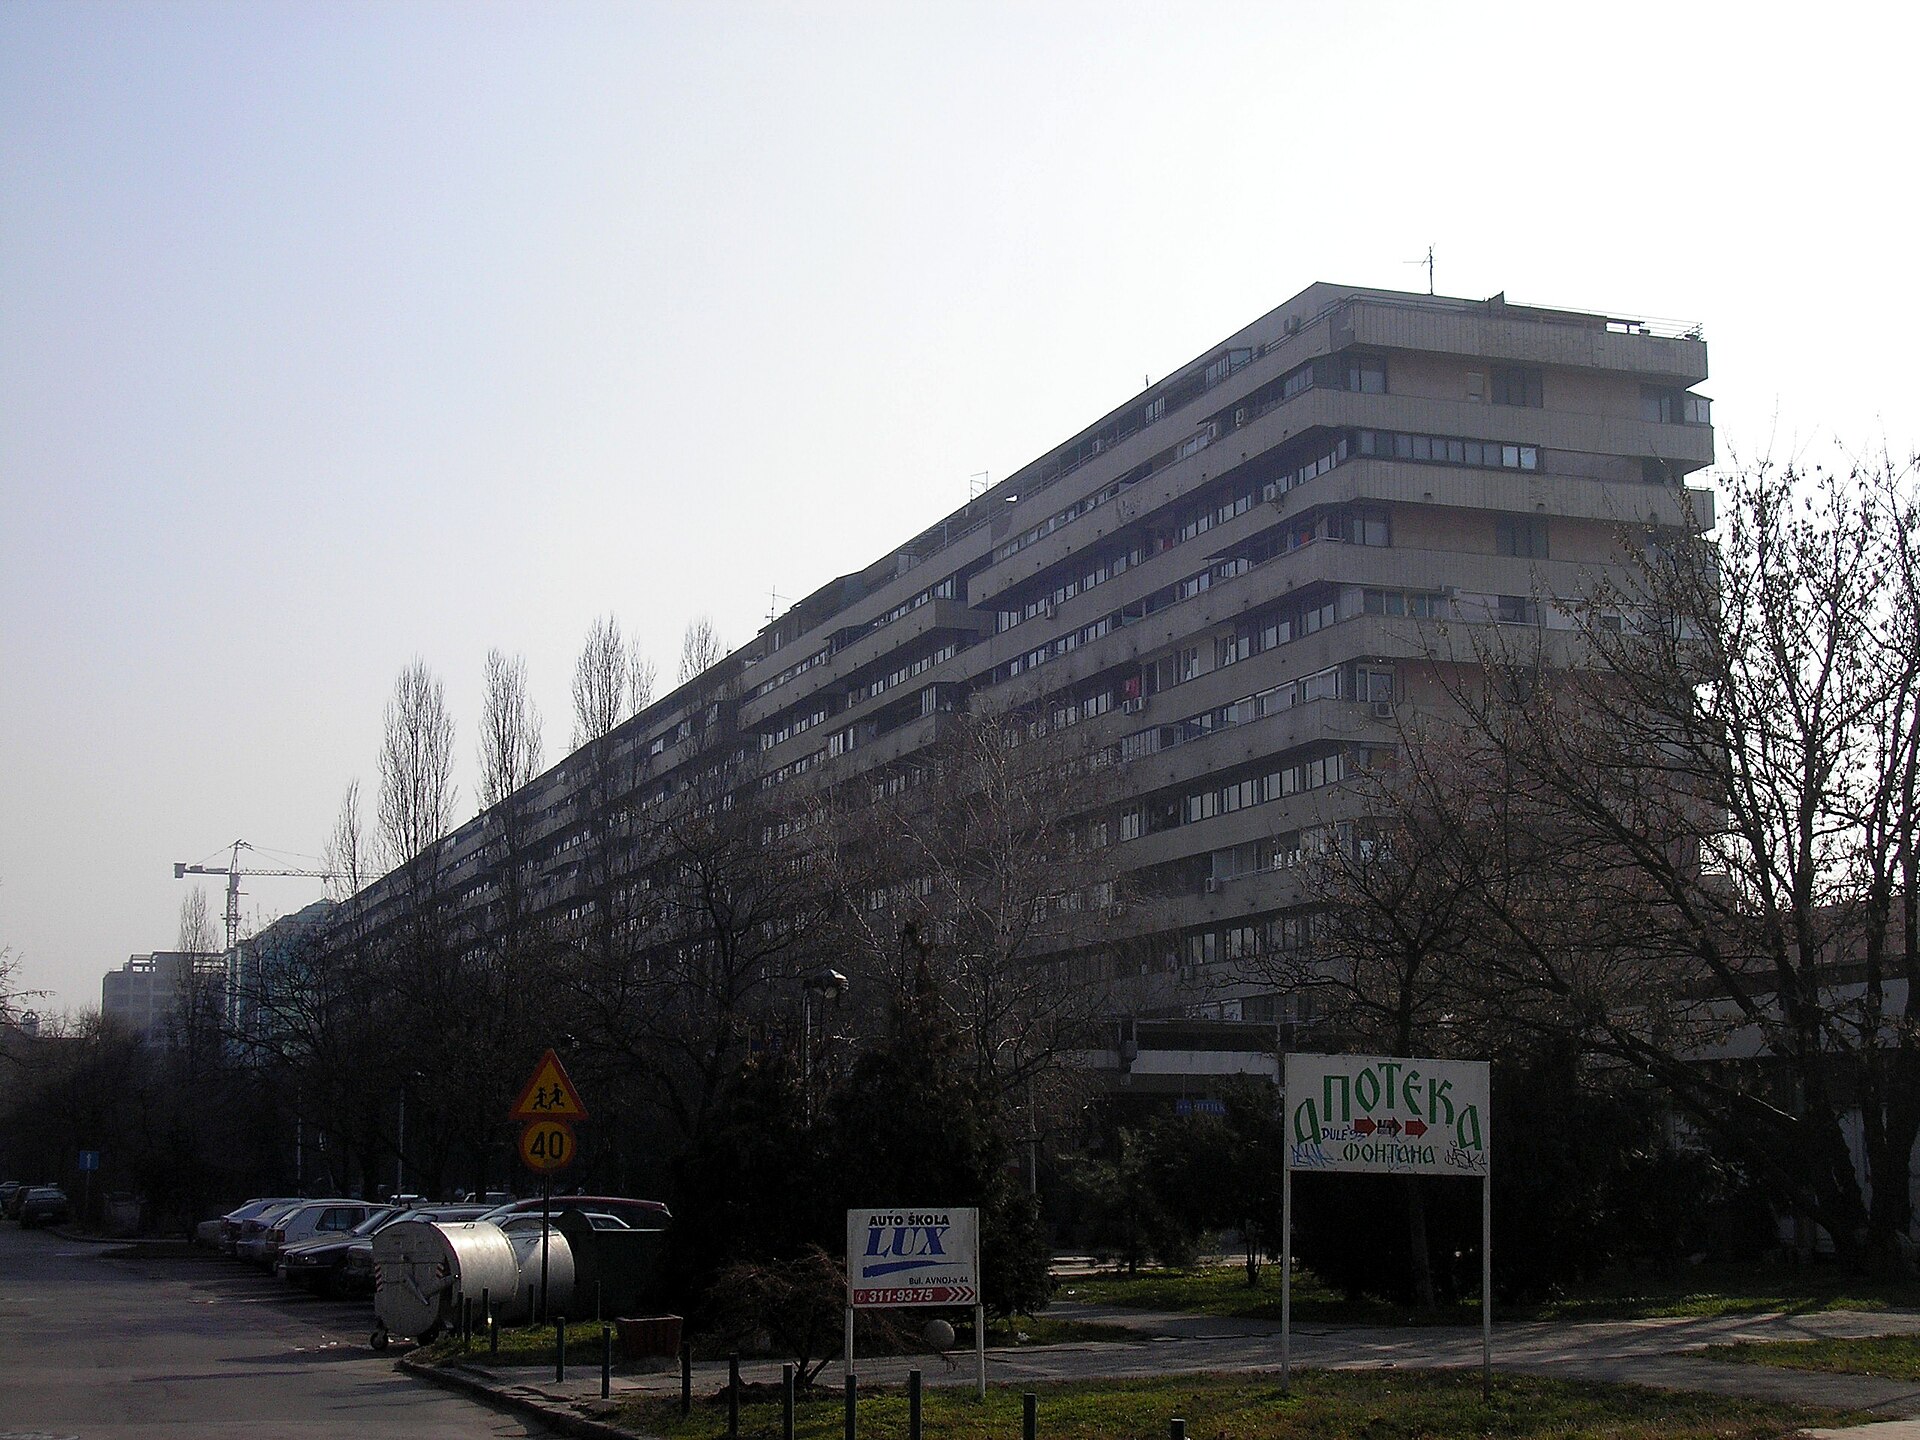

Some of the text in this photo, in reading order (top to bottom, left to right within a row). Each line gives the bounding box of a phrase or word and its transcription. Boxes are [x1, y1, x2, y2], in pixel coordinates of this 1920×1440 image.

[1293, 1062, 1483, 1151] АПОТЕКА
[530, 1131, 564, 1159] 40
[868, 1212, 950, 1226] AUTO ŠKOLA
[863, 1226, 951, 1258] LUX
